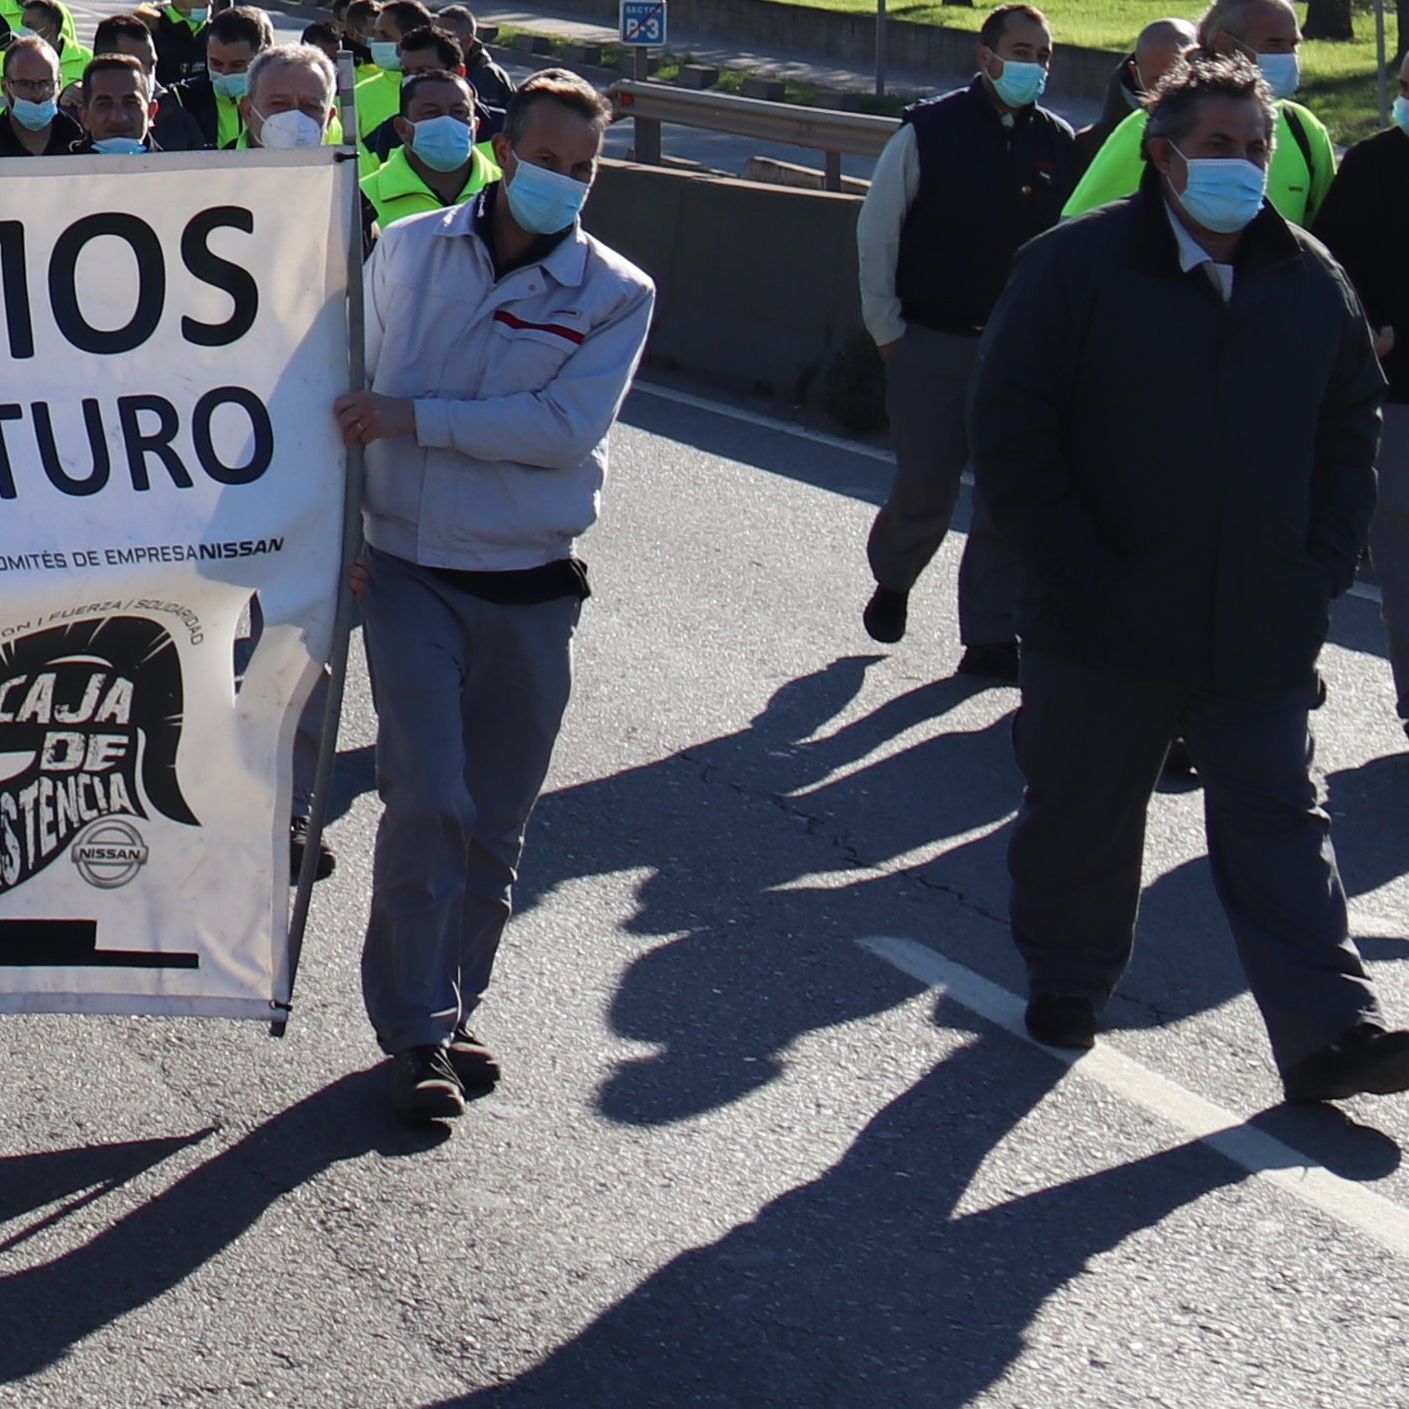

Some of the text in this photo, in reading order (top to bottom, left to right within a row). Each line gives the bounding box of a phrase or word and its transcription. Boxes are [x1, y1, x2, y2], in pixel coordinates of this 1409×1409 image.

[73, 549, 101, 568] DE
[48, 599, 122, 622] FUERZA
[39, 731, 130, 772] DE
[79, 847, 142, 861] NISSAN
